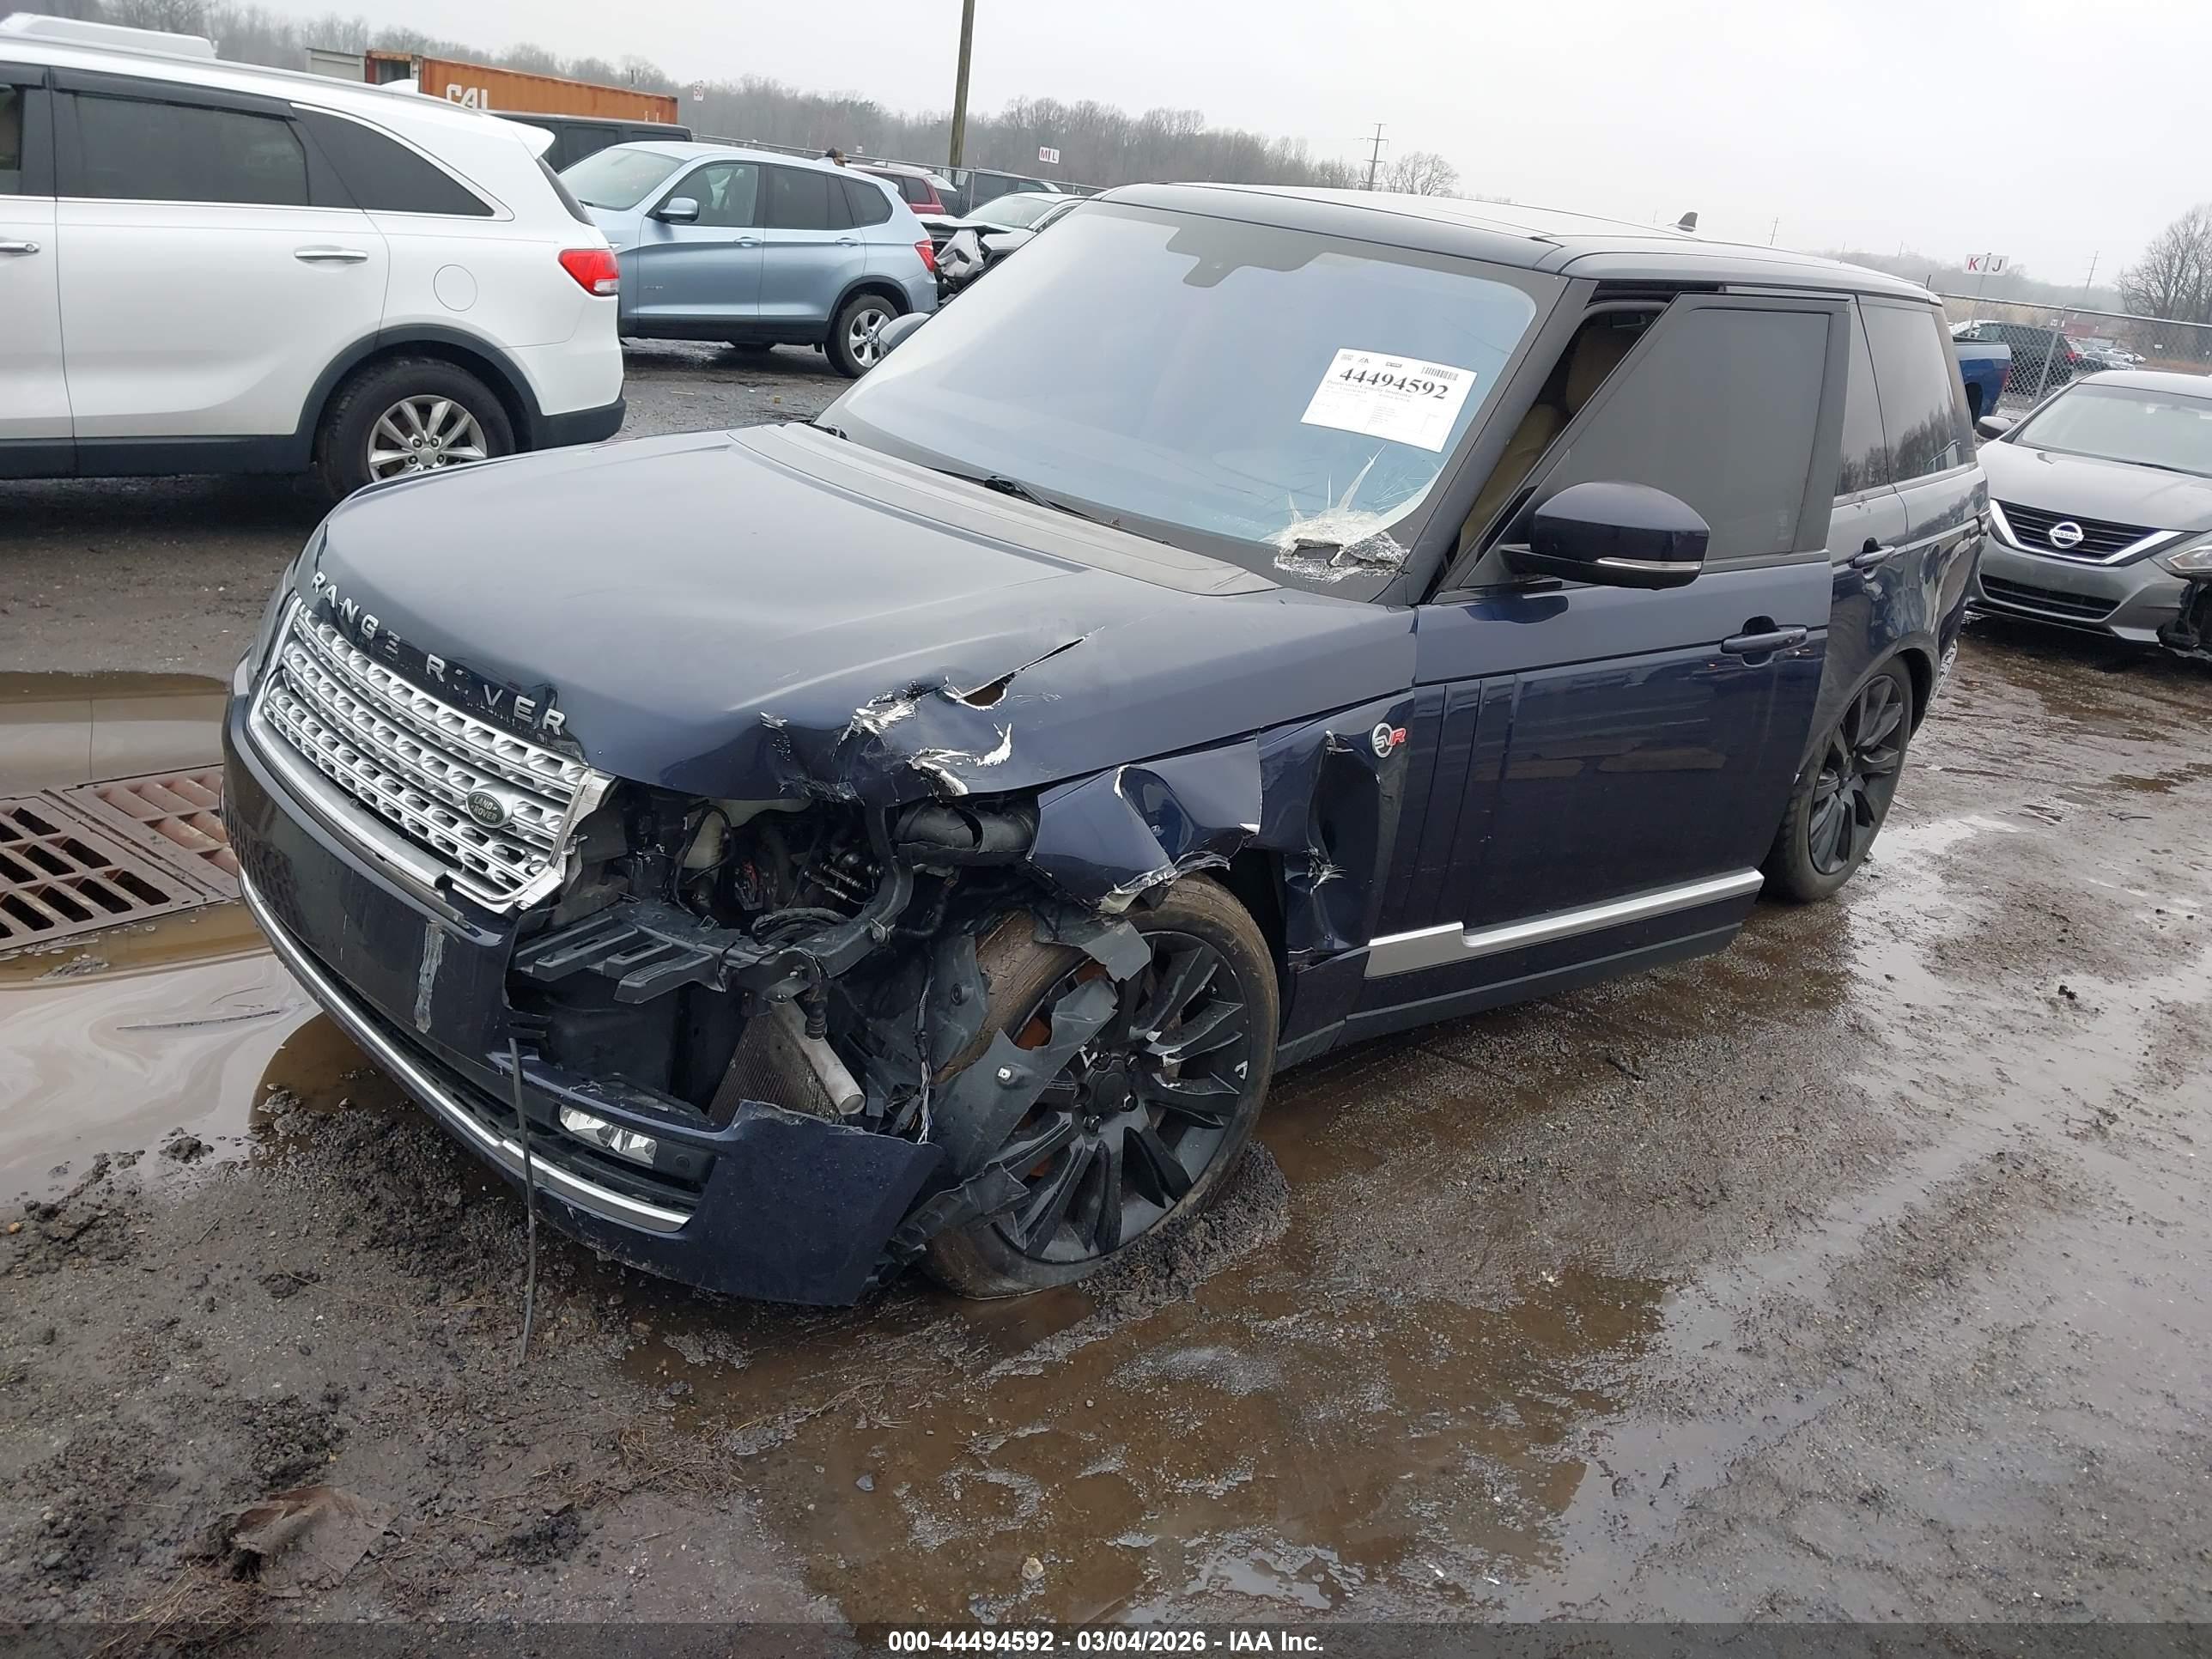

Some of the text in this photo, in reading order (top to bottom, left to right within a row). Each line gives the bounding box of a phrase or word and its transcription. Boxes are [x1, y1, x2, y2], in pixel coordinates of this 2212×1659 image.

[1040, 149, 1057, 161] M L
[1968, 257, 2002, 272] K J
[1339, 368, 1449, 399] 44494592
[2052, 530, 2080, 539] NISSAN
[310, 571, 565, 736] RANGE RVER
[1373, 726, 1407, 750] SVR
[474, 795, 494, 811] LAND
[473, 805, 497, 822] ROVER
